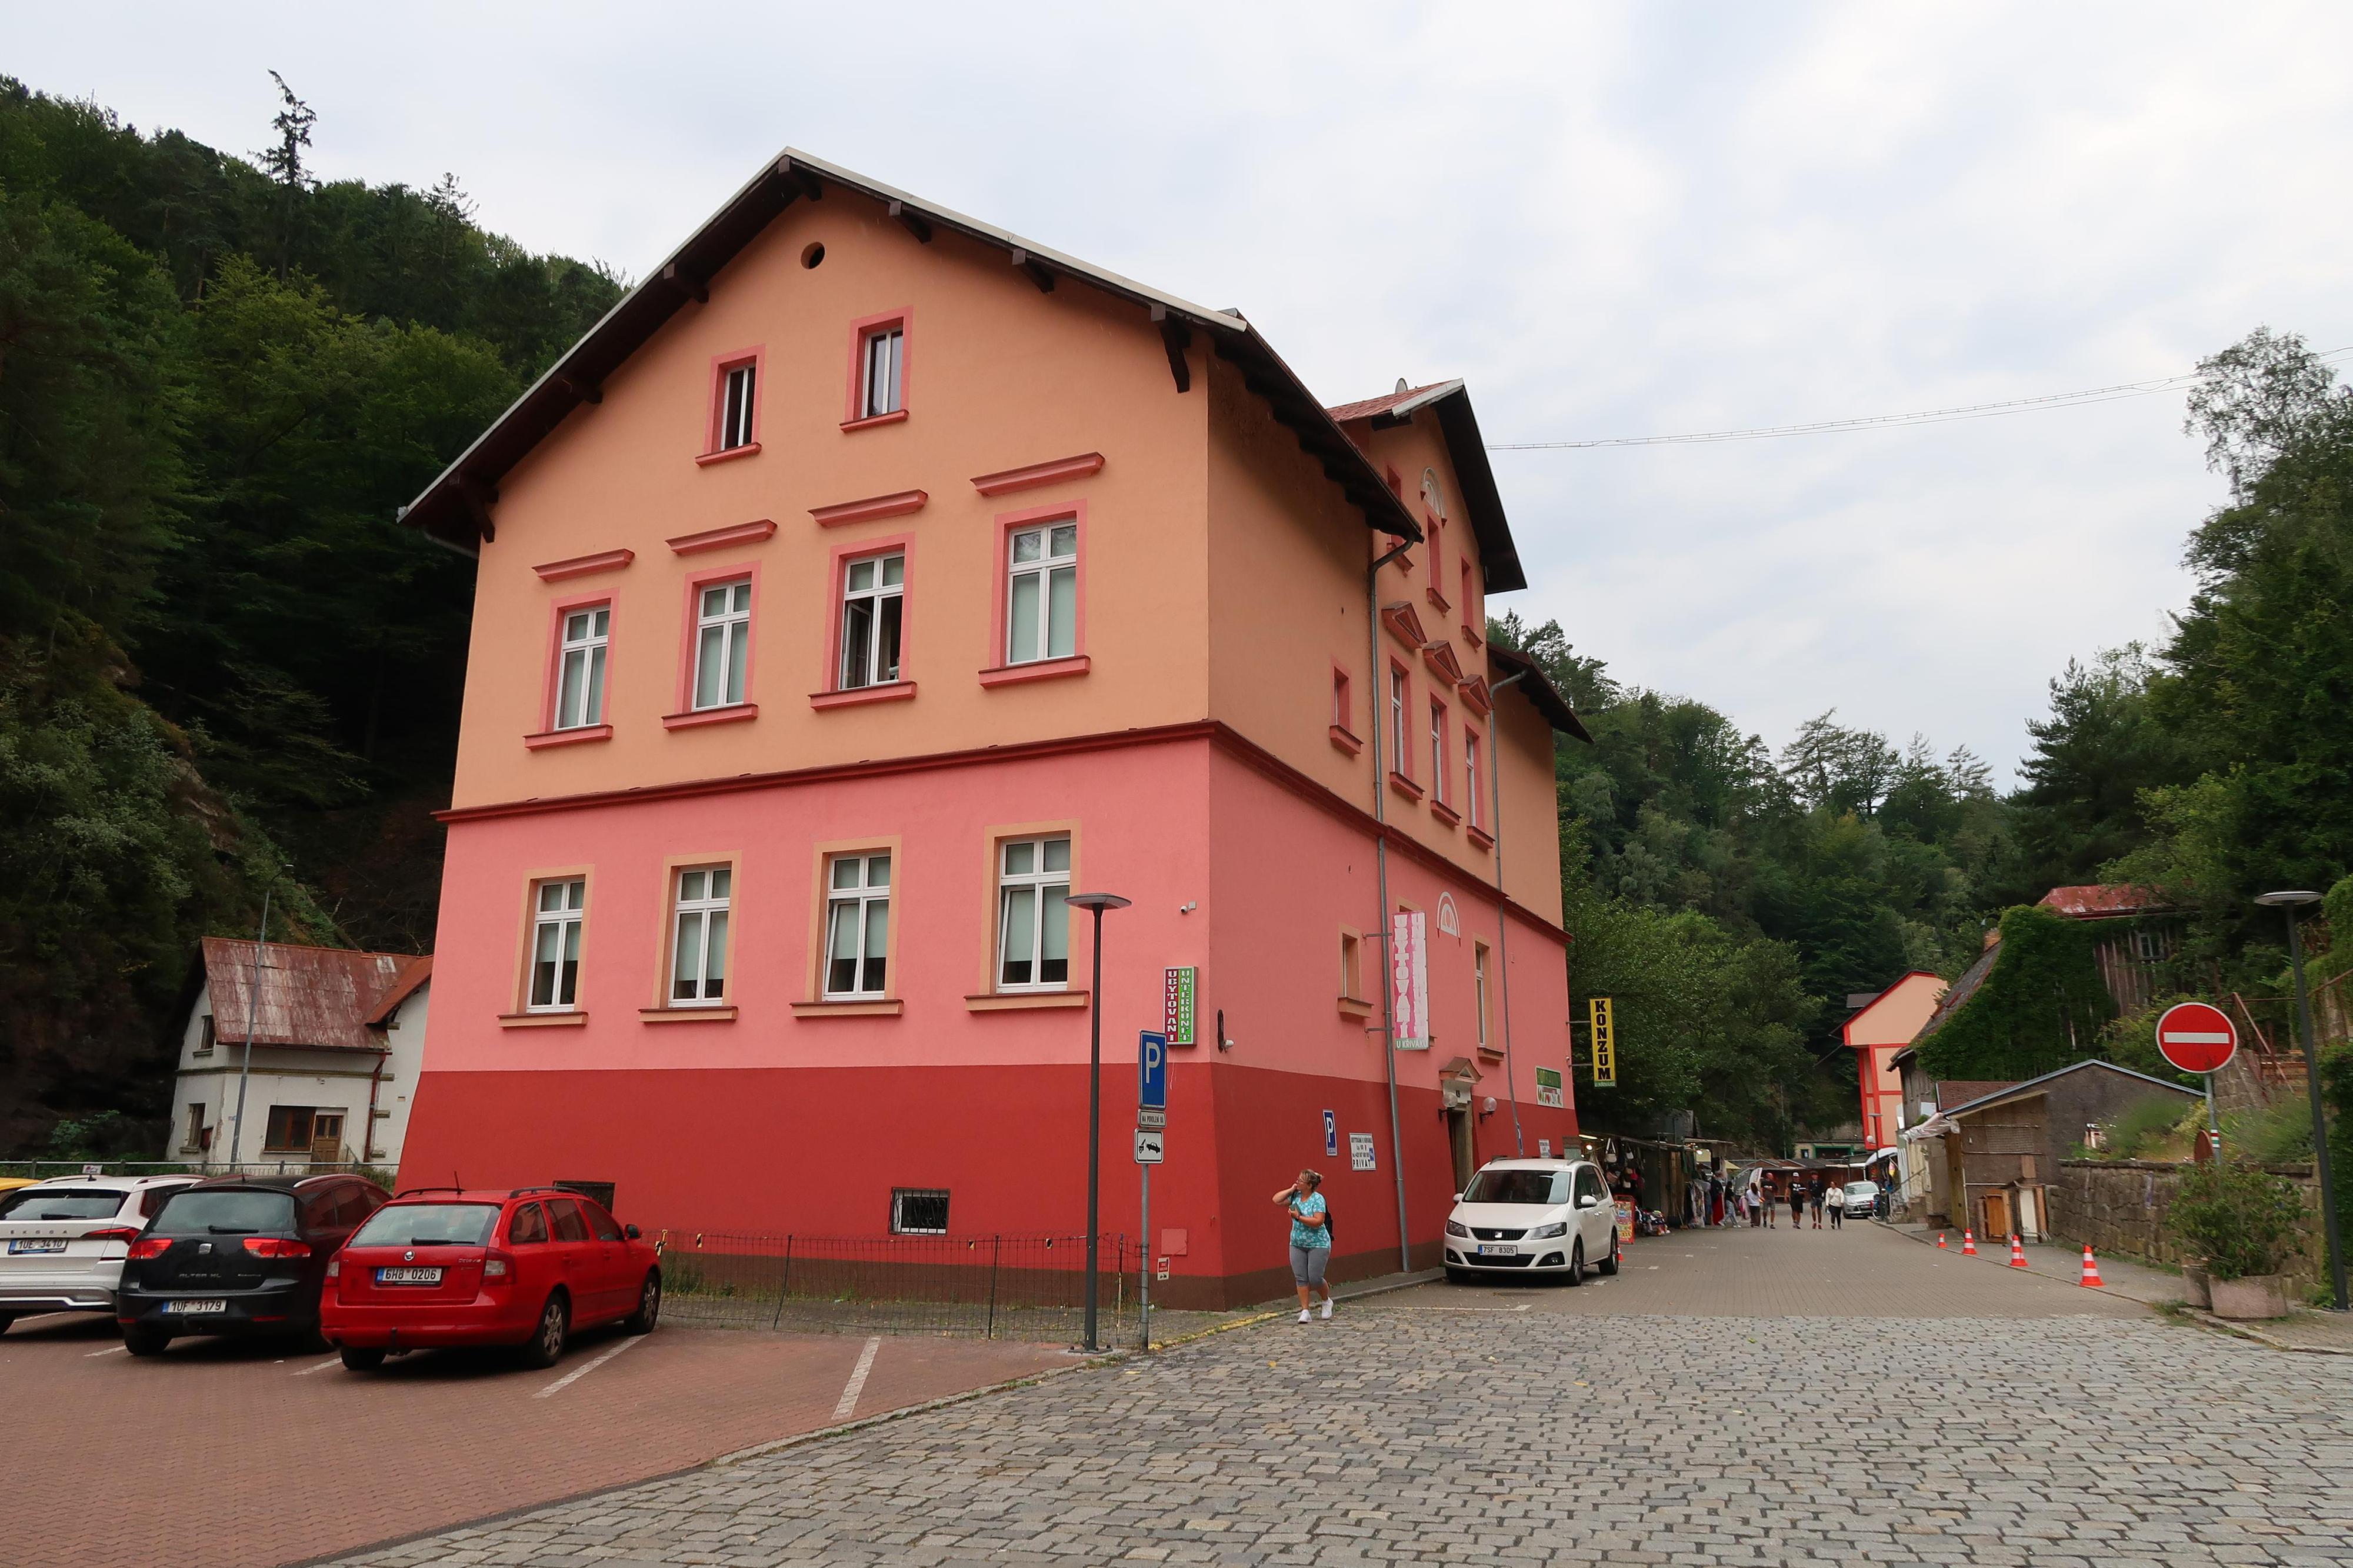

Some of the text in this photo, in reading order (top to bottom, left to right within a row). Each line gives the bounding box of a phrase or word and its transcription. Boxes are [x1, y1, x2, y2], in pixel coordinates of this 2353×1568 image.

[1180, 970, 1191, 1041] UNTERKUNFT
[1397, 1040, 1401, 1048] U
[1595, 1000, 1611, 1080] KONZUM
[1146, 1042, 1161, 1083] P
[1327, 1117, 1334, 1143] P
[1353, 1159, 1371, 1167] PRIVAT
[19, 1239, 63, 1249] 1UE 3410
[385, 1269, 436, 1280] 6H8 0206
[172, 1301, 222, 1312] 1UF 3179
